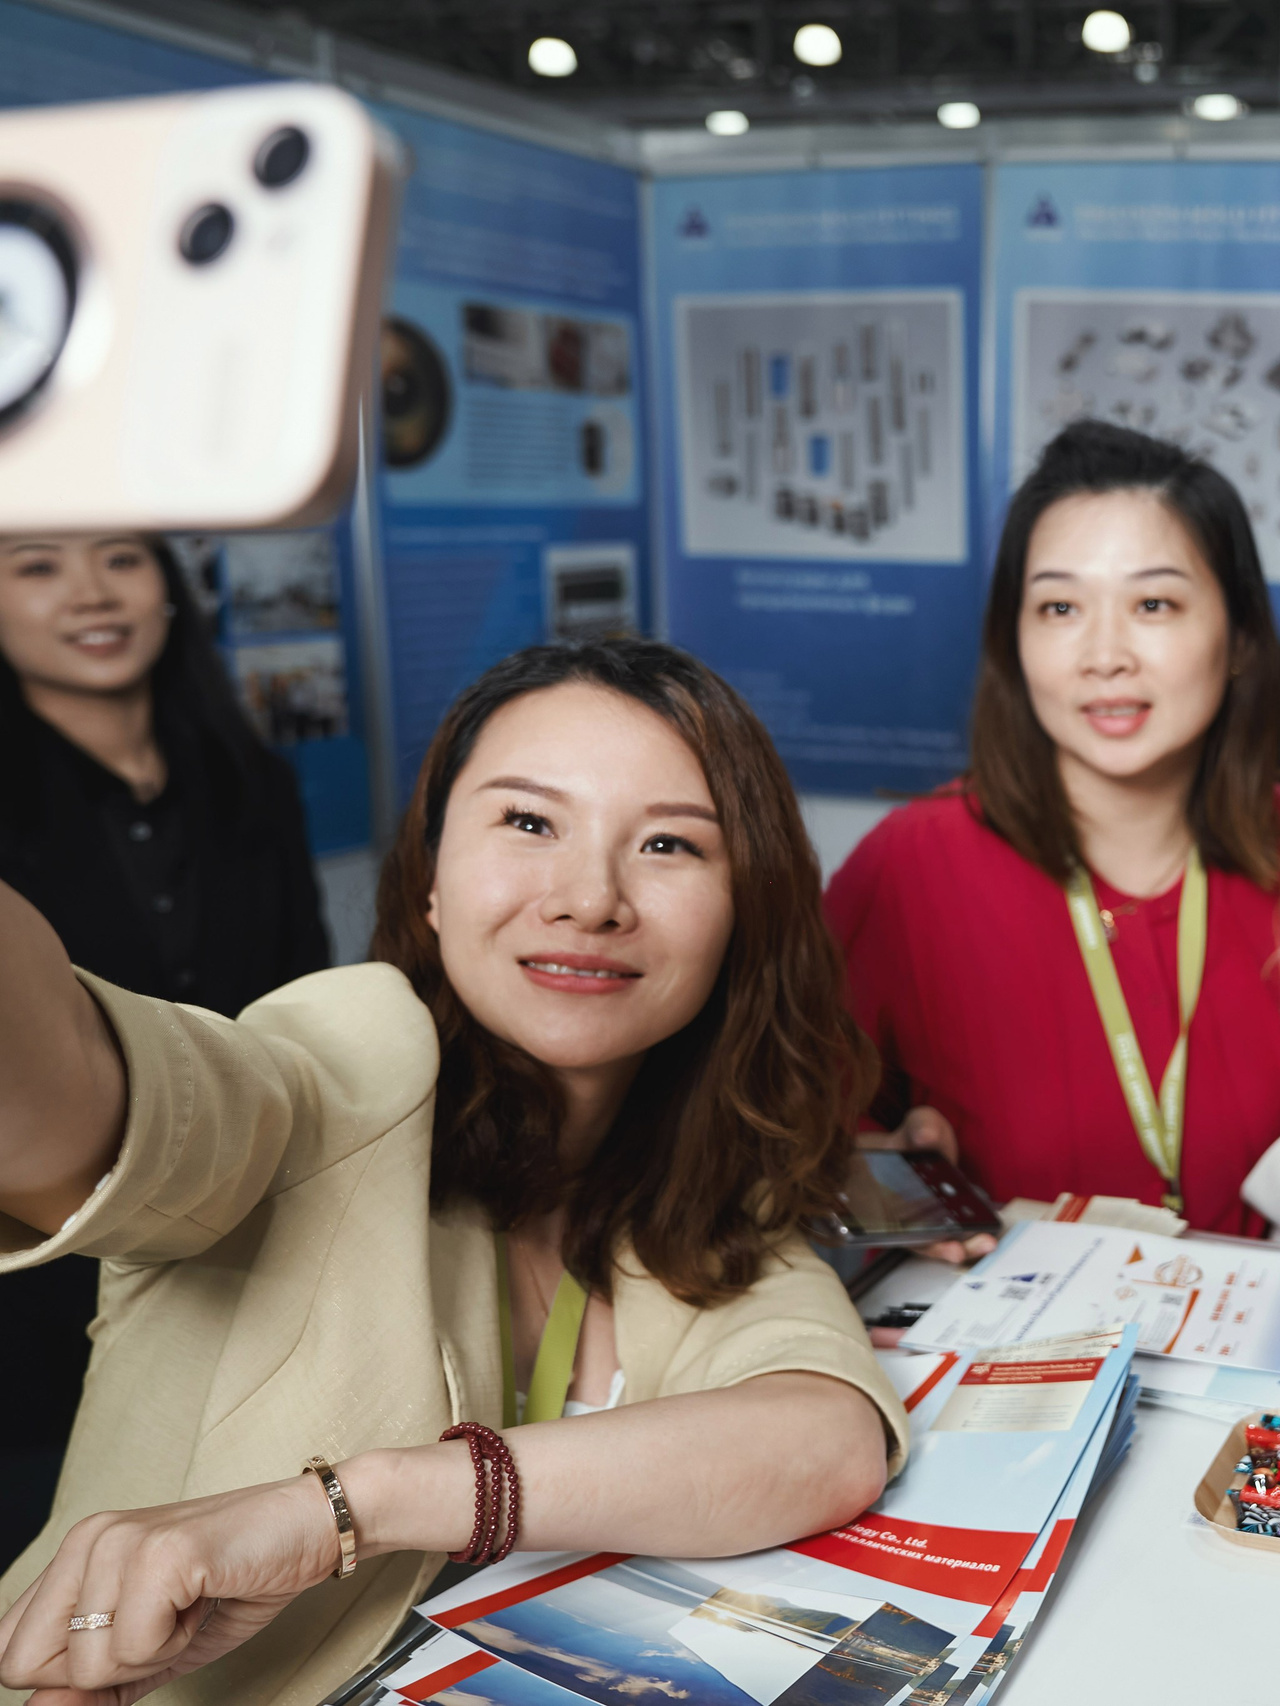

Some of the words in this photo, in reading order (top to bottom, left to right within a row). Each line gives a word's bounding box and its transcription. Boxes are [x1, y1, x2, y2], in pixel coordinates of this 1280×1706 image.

[879, 1531, 902, 1544] Co.,
[904, 1536, 928, 1549] Ltd.
[923, 1554, 1001, 1573] материалов
